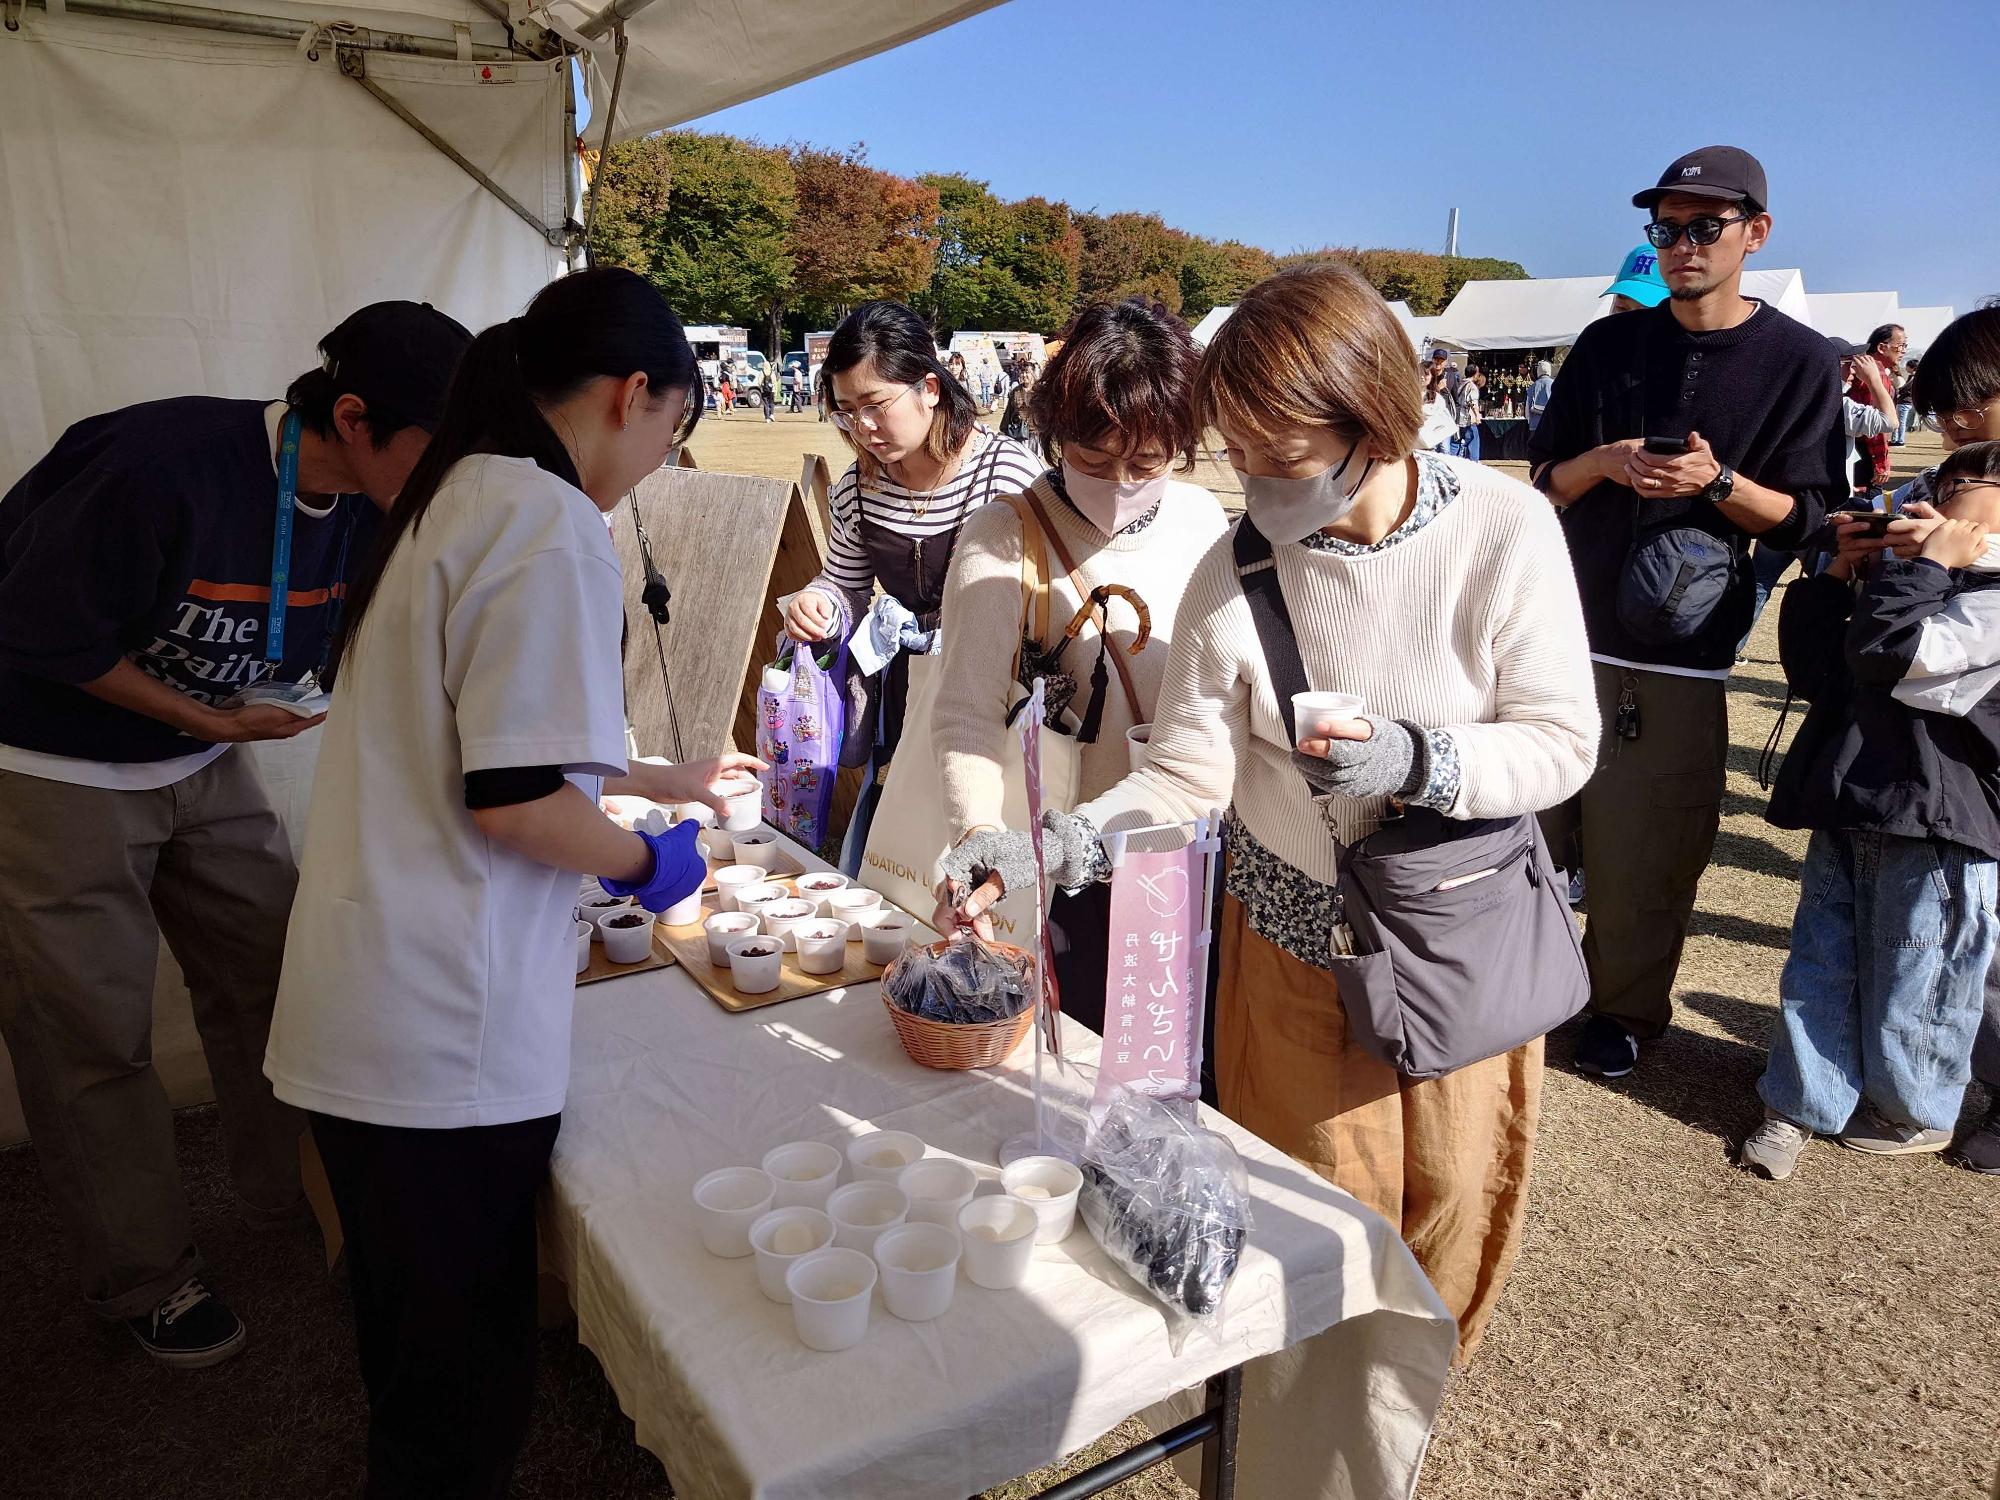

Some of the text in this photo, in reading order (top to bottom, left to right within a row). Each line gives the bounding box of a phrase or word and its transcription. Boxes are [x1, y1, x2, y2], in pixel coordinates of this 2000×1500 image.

[169, 602, 260, 643] The
[143, 636, 269, 691] Daily
[863, 850, 917, 883] NDATION
